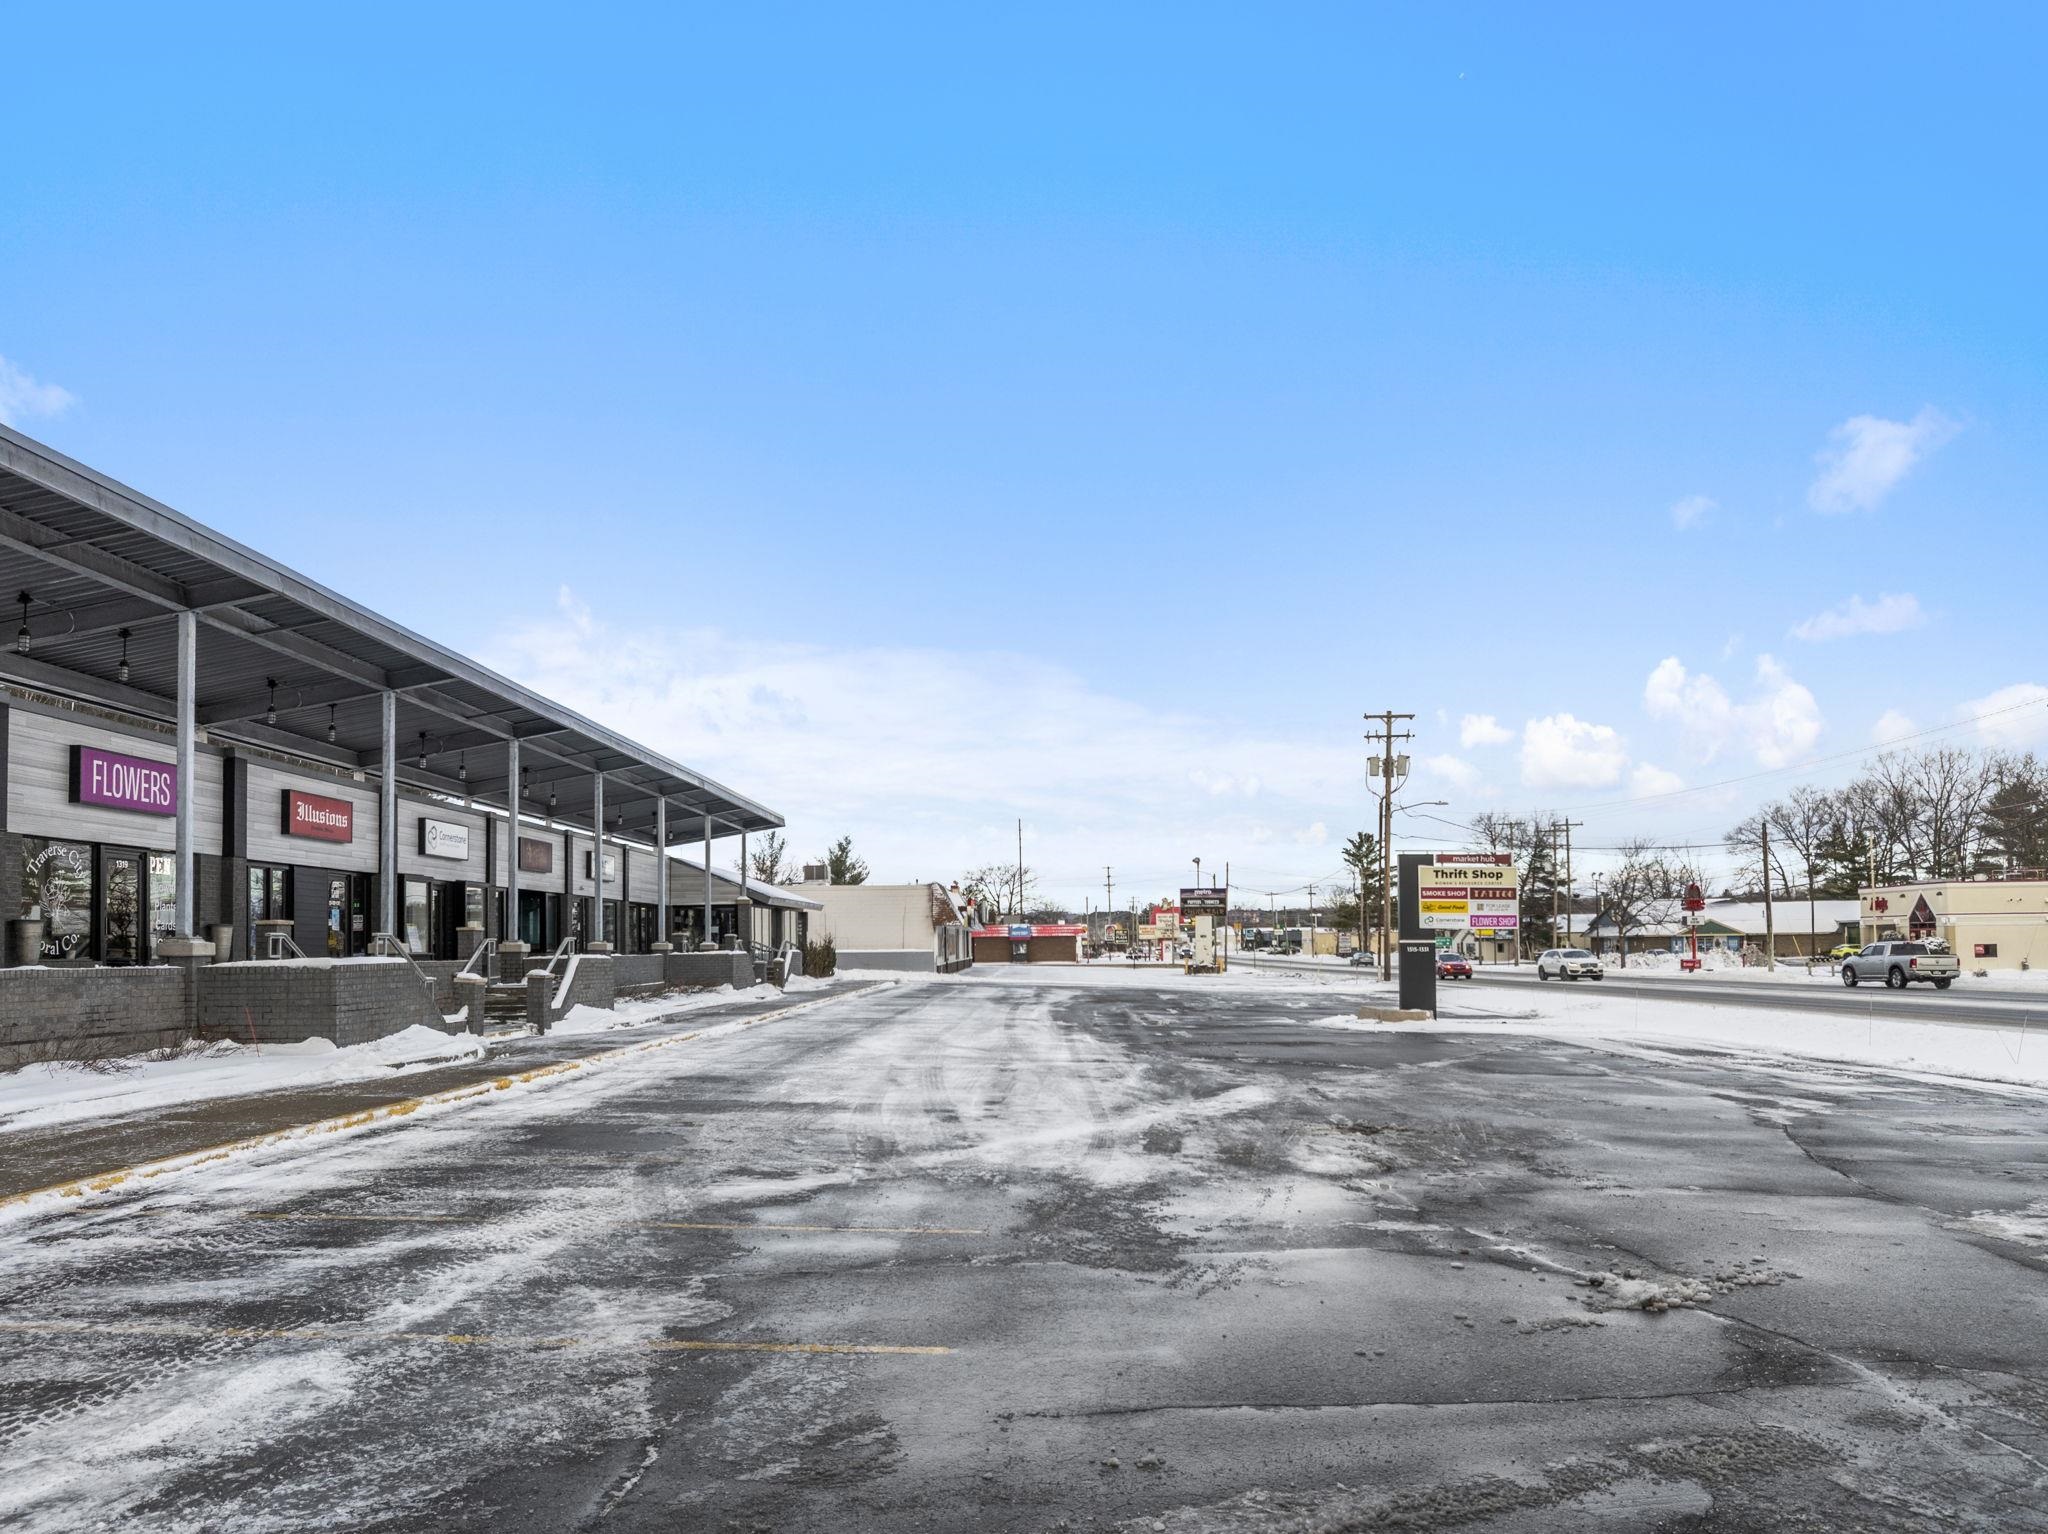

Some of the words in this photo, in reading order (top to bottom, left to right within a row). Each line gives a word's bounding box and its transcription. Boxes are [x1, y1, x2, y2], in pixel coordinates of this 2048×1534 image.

[93, 760, 171, 806] FLOWERS
[296, 801, 348, 828] Illusions
[26, 845, 67, 875] Traverse
[68, 850, 86, 879] City
[116, 860, 129, 869] 1319
[1480, 855, 1496, 863] hub
[149, 856, 171, 875] PEN
[1433, 869, 1468, 879] Thrift
[1472, 869, 1503, 880] Shop
[1194, 889, 1212, 897] metro
[155, 919, 176, 931] Cards
[1471, 916, 1498, 926] FLOWER
[1498, 917, 1516, 927] SHOP
[40, 940, 60, 956] oral
[61, 934, 80, 951] Co.
